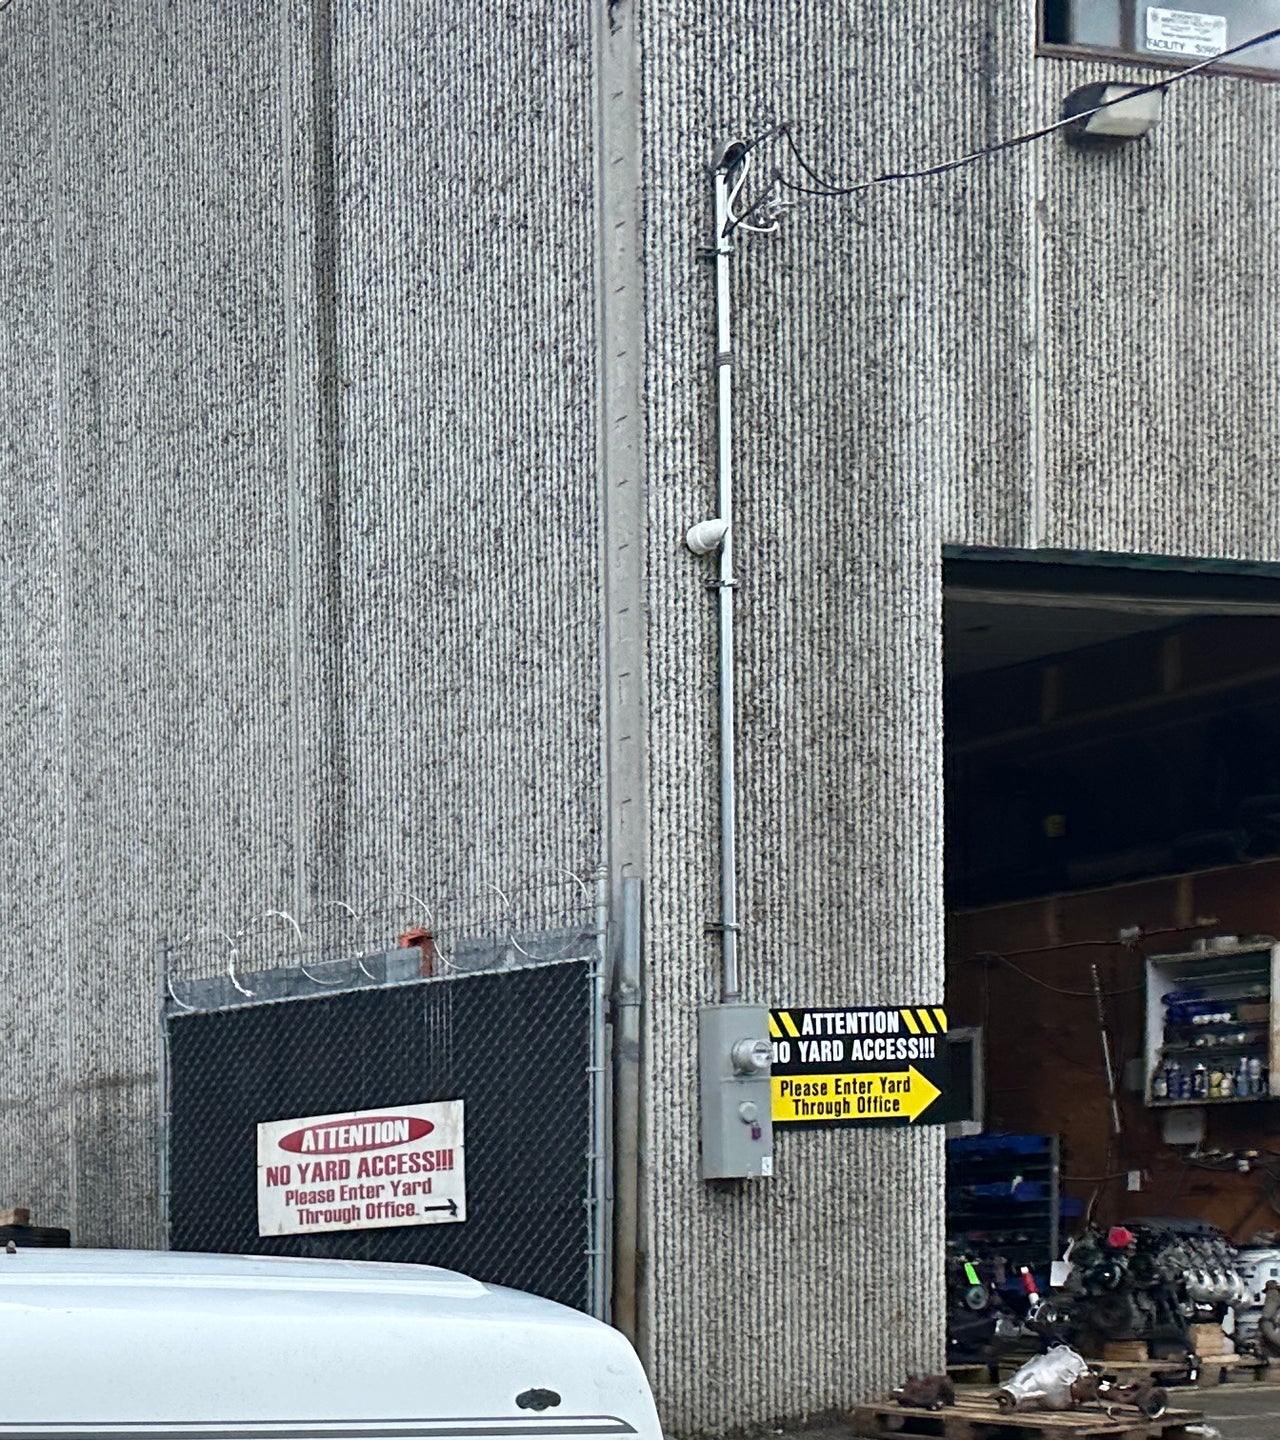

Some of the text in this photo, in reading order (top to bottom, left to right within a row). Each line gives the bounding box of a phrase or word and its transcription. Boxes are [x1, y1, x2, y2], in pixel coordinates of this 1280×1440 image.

[802, 1011, 900, 1035] ATTENTION
[798, 1040, 844, 1063] YARD
[851, 1037, 935, 1061] ACCESS!!!
[780, 1075, 911, 1098] Please Enter Yard
[793, 1096, 900, 1117] Through Office
[301, 1119, 409, 1152] ATTENTION
[266, 1149, 454, 1187] NO YARD ACCESS!!!
[285, 1178, 432, 1206] Please Enter Yard
[297, 1203, 361, 1225] Through
